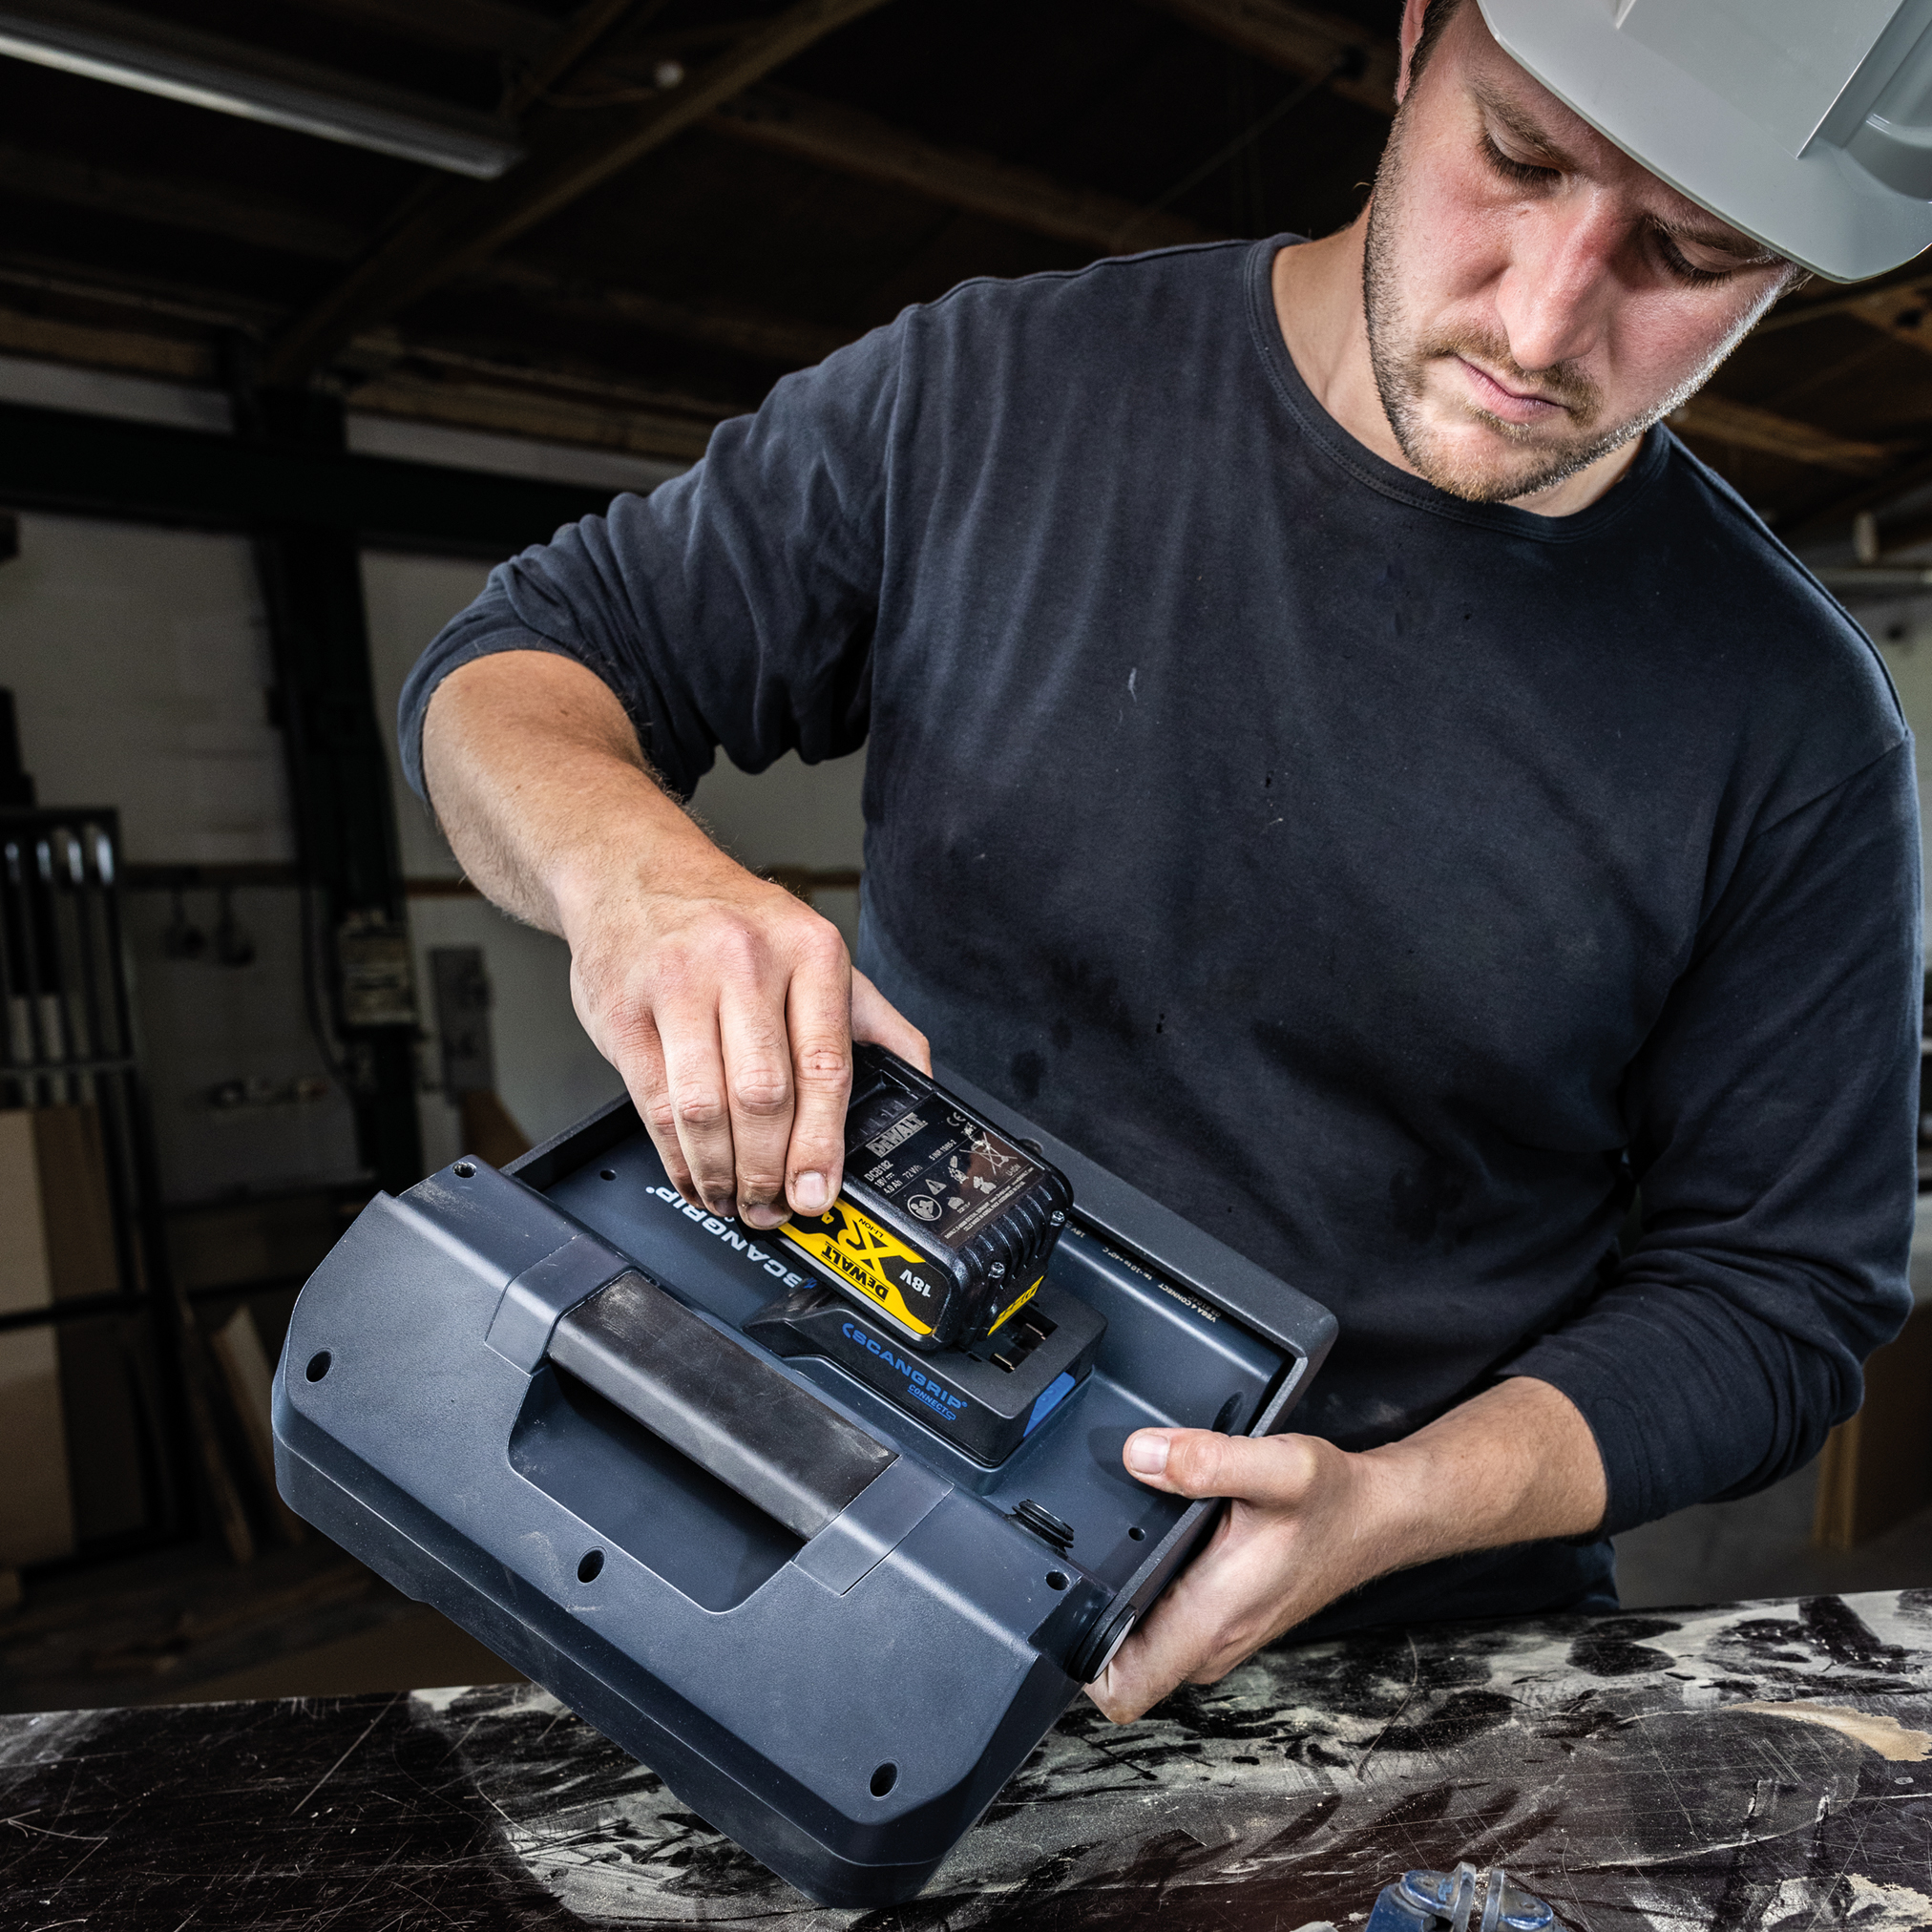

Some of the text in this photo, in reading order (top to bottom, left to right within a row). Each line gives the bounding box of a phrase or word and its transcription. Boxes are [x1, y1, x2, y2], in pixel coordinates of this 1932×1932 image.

[858, 1217, 884, 1238] LI-ION
[821, 1241, 890, 1302] DEWALT
[899, 1269, 932, 1298] 18V
[1158, 1283, 1192, 1307] CONNECT
[1196, 1307, 1217, 1323] VEGA
[851, 1329, 963, 1411] SCANGRIP
[909, 1384, 949, 1417] CONNECT
